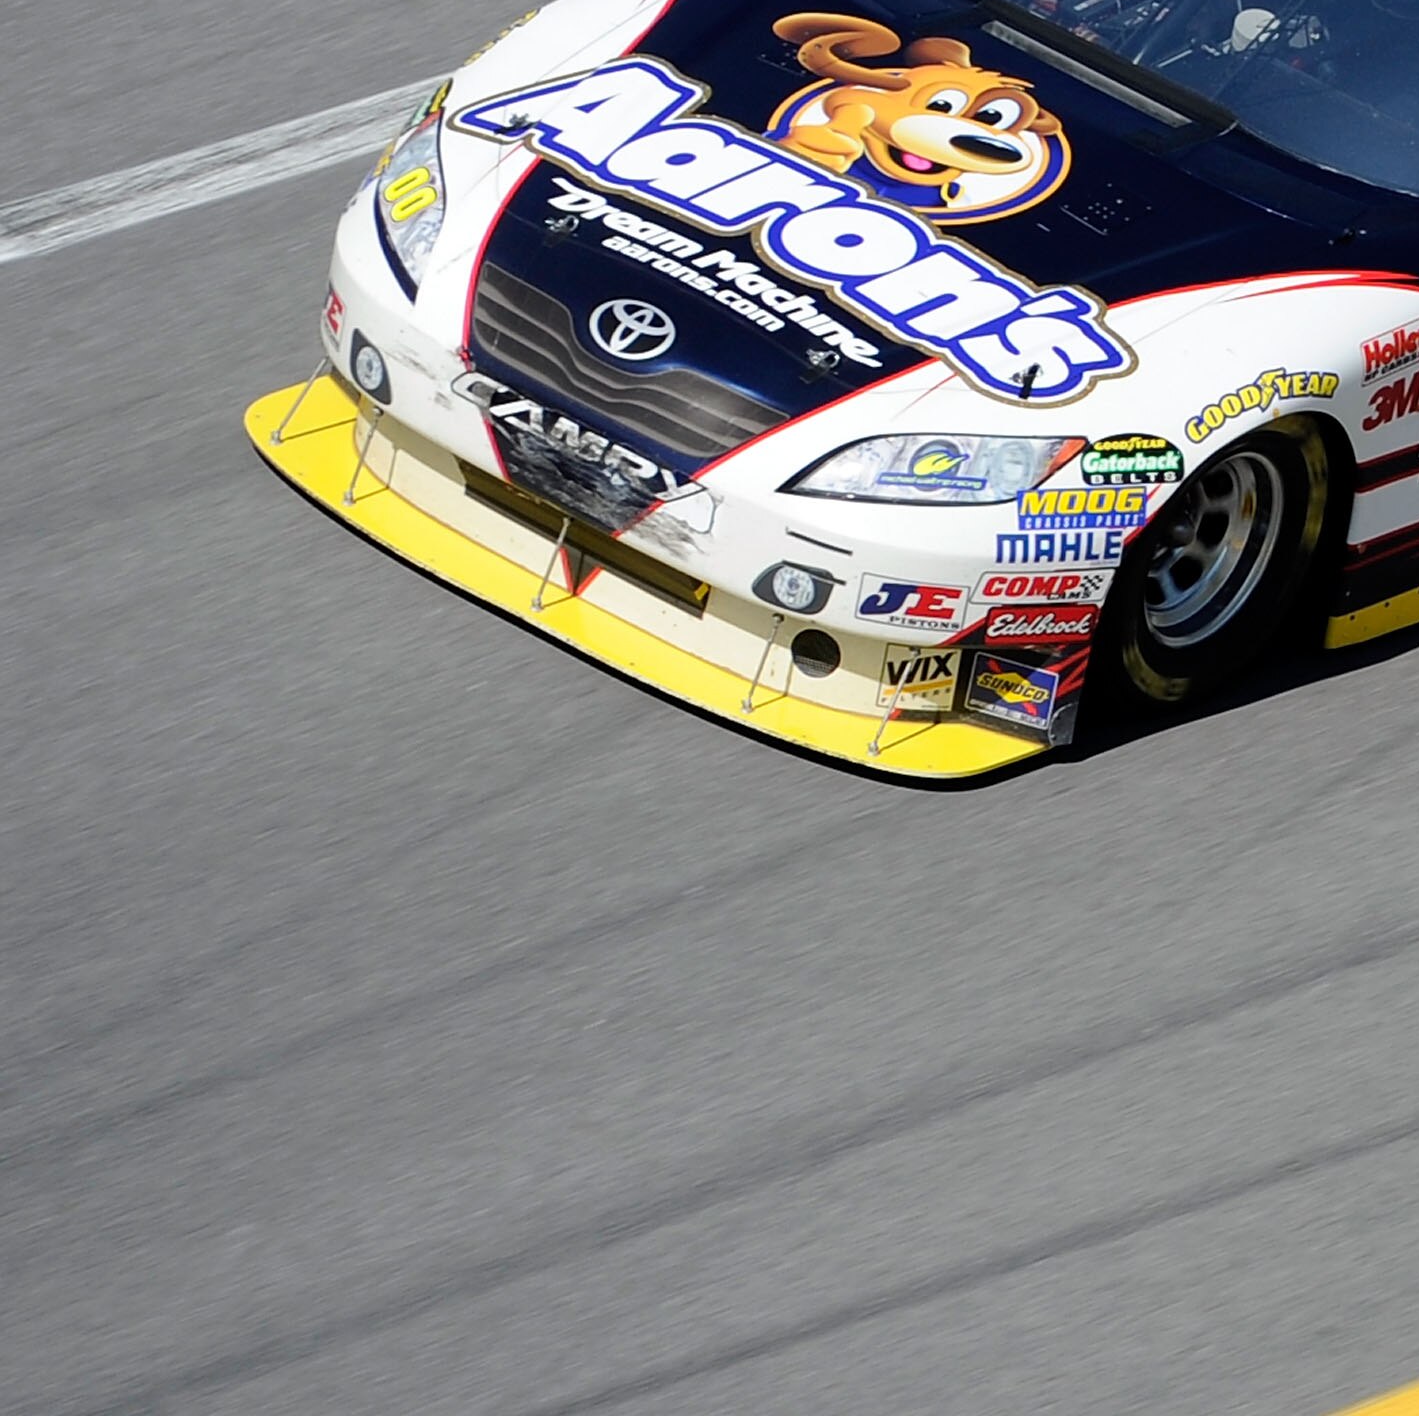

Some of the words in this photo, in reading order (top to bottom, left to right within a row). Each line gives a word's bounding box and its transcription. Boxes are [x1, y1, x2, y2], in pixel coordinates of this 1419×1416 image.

[383, 166, 438, 222] 00
[456, 58, 1127, 401] Aaron's
[547, 176, 704, 255] Dream
[694, 249, 884, 369] Machine
[600, 234, 786, 333] aarons.com
[1185, 368, 1340, 443] GOODYEAR
[1093, 437, 1167, 452] GOODYEAR
[1083, 450, 1181, 473] Gatorback
[1090, 471, 1178, 484] BELTS
[1019, 487, 1145, 517] MOOG
[1025, 516, 1087, 529] CHASSIS
[1095, 514, 1141, 527] PARTS
[995, 531, 1123, 564] MAHLE
[859, 582, 963, 621] JE
[982, 575, 1082, 598] COMP
[888, 615, 962, 631] PISTONS
[986, 612, 1093, 639] Edelbrock
[886, 652, 957, 686] WIX
[880, 686, 952, 705] FLTERS
[977, 673, 1048, 704] SUNOCO
